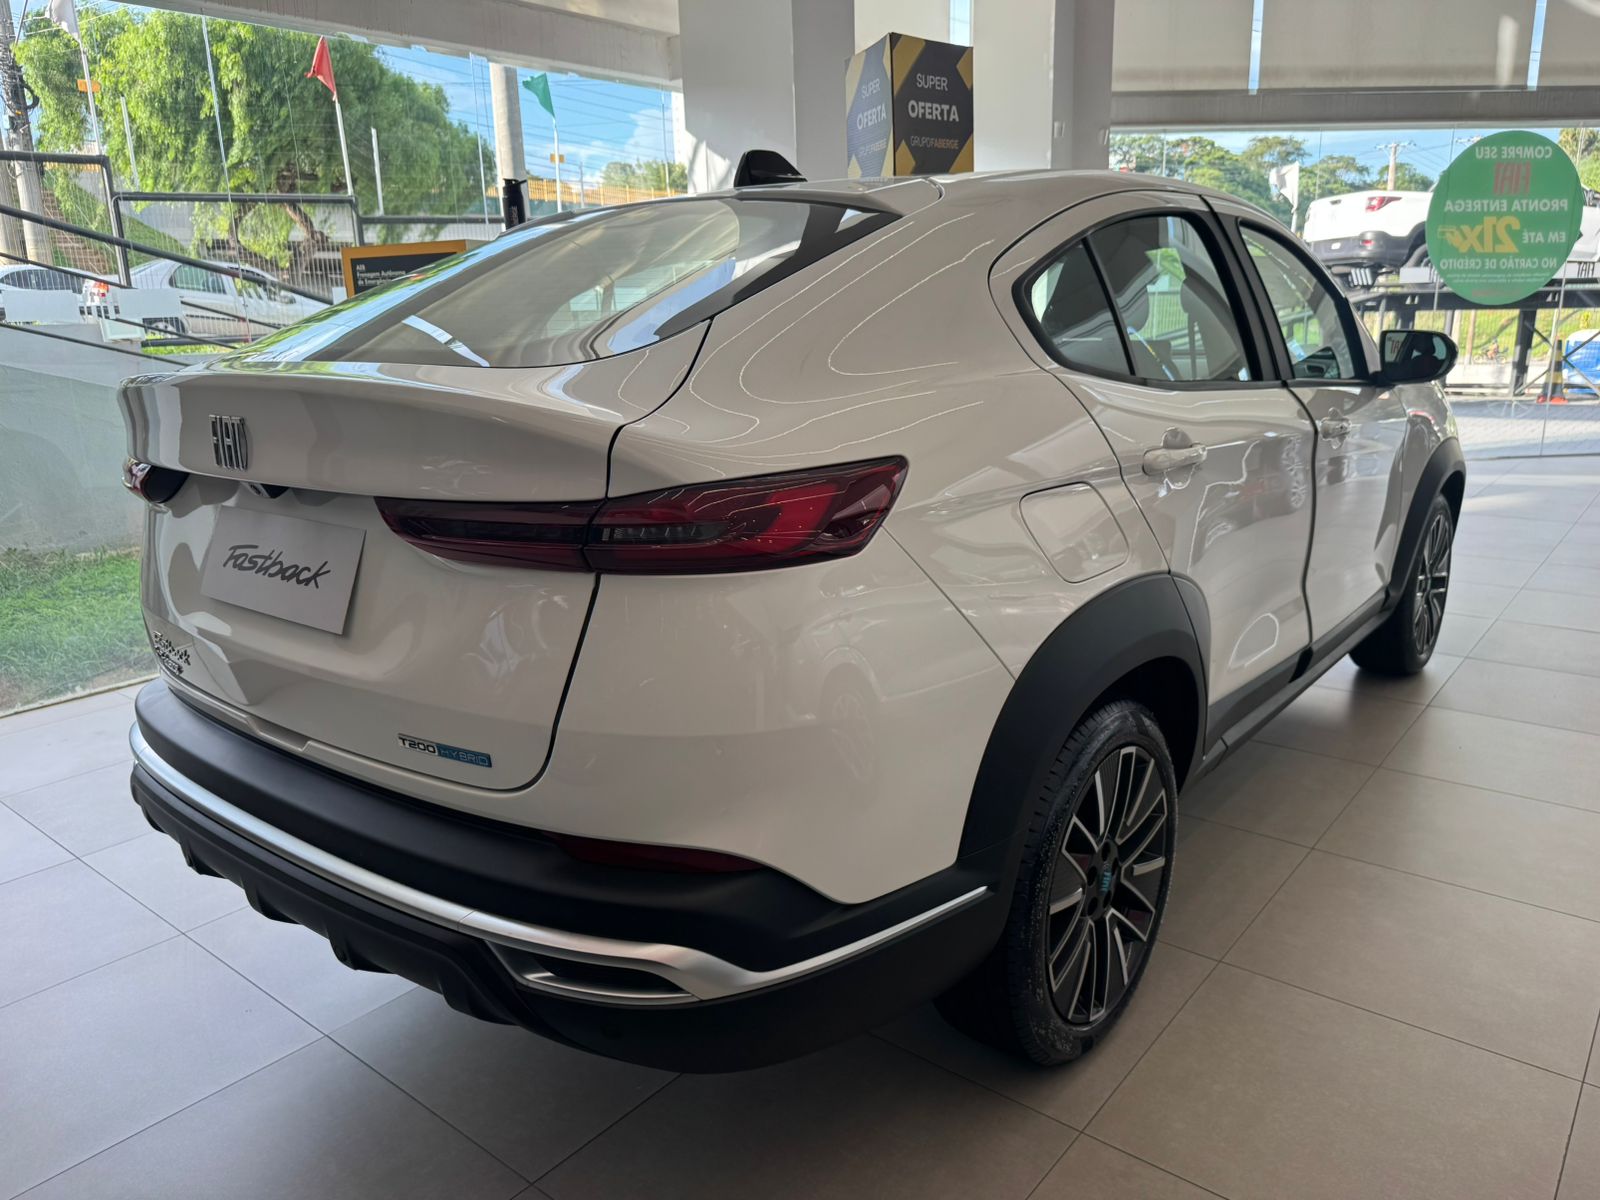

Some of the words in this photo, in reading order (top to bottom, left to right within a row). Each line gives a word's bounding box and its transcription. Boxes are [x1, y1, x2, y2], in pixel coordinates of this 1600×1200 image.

[862, 78, 880, 99] SUPER
[916, 73, 948, 91] SUPER
[857, 103, 887, 130] OFERTA
[908, 100, 959, 122] OFERTA
[209, 414, 248, 471] FIAT
[223, 544, 331, 589] Fastback
[398, 736, 436, 754] T200
[441, 749, 489, 766] HYBRID
